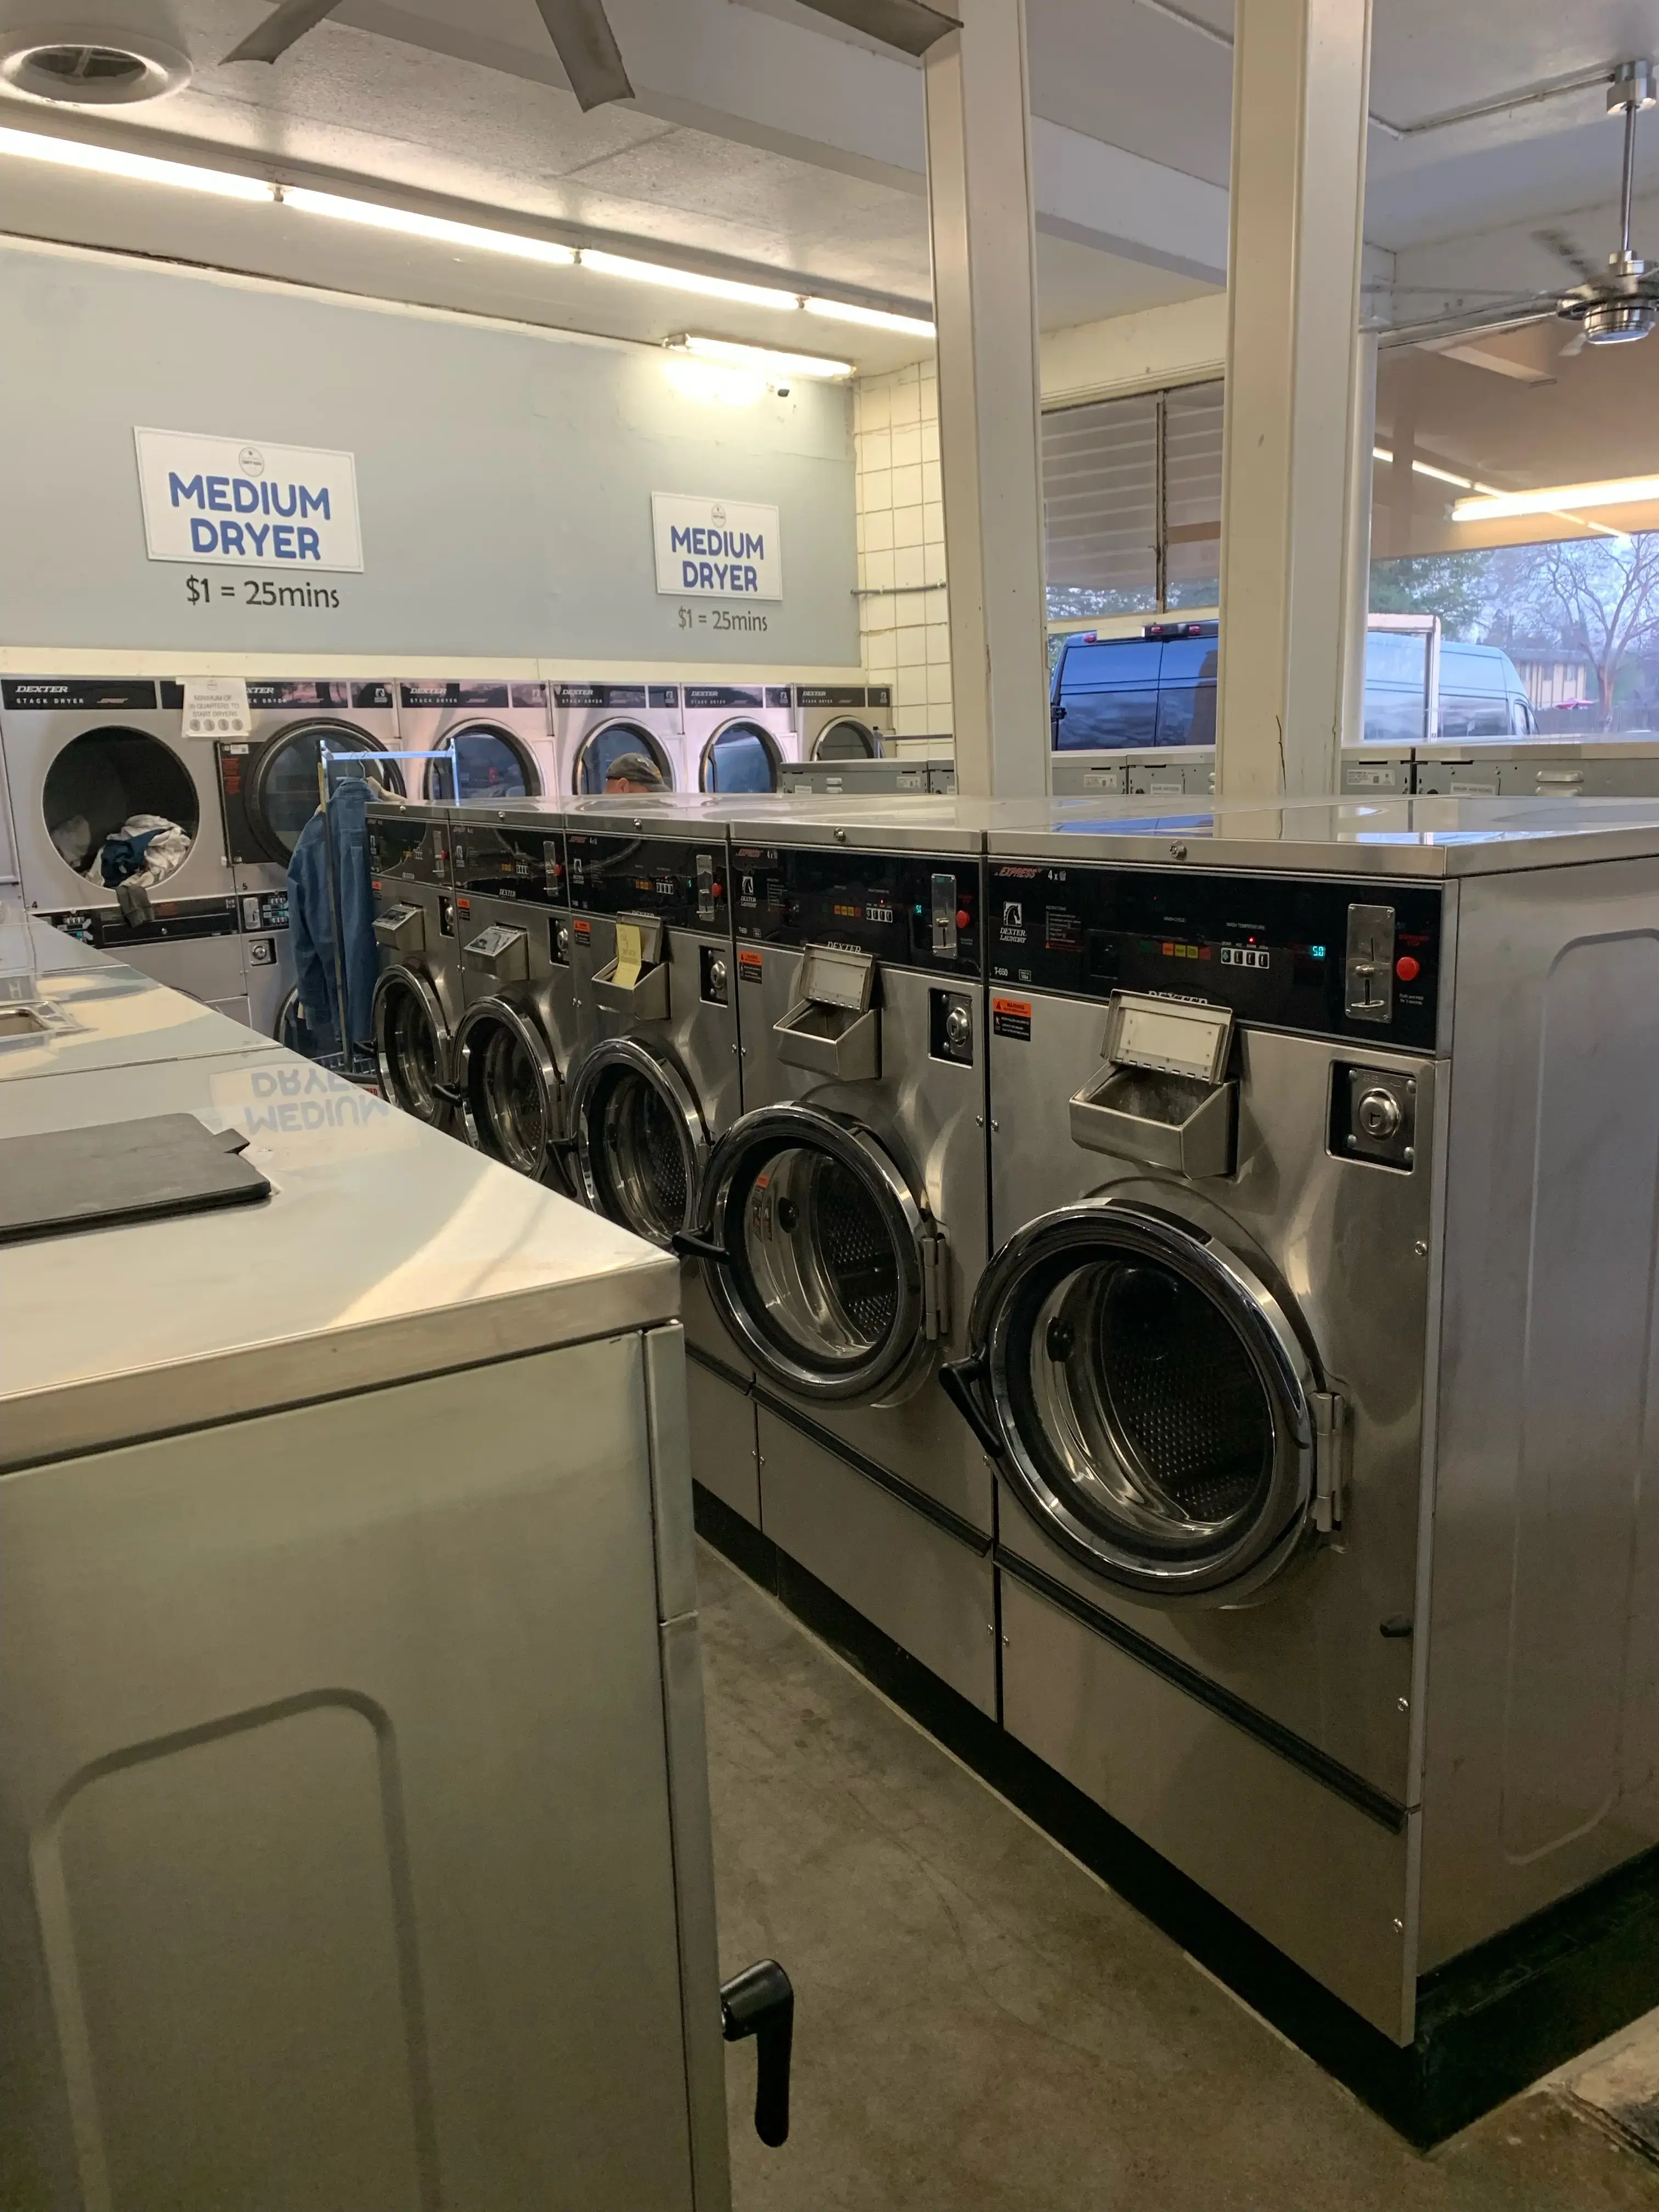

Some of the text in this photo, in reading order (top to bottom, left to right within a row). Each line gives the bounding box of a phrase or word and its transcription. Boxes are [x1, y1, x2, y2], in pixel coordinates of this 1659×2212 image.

[168, 472, 331, 520] MEDIUM
[190, 517, 321, 561] DRYER
[670, 525, 764, 560] MEDIUM
[682, 560, 758, 592] DRYER
[185, 574, 340, 608] $1 = 25mins
[678, 606, 768, 632] $1 = 25mins
[998, 866, 1037, 879] EXPRESS
[242, 883, 248, 891] 5
[999, 934, 1027, 944] LAUNDRY
[1000, 927, 1026, 937] DEXTER
[994, 966, 1008, 977] T-650
